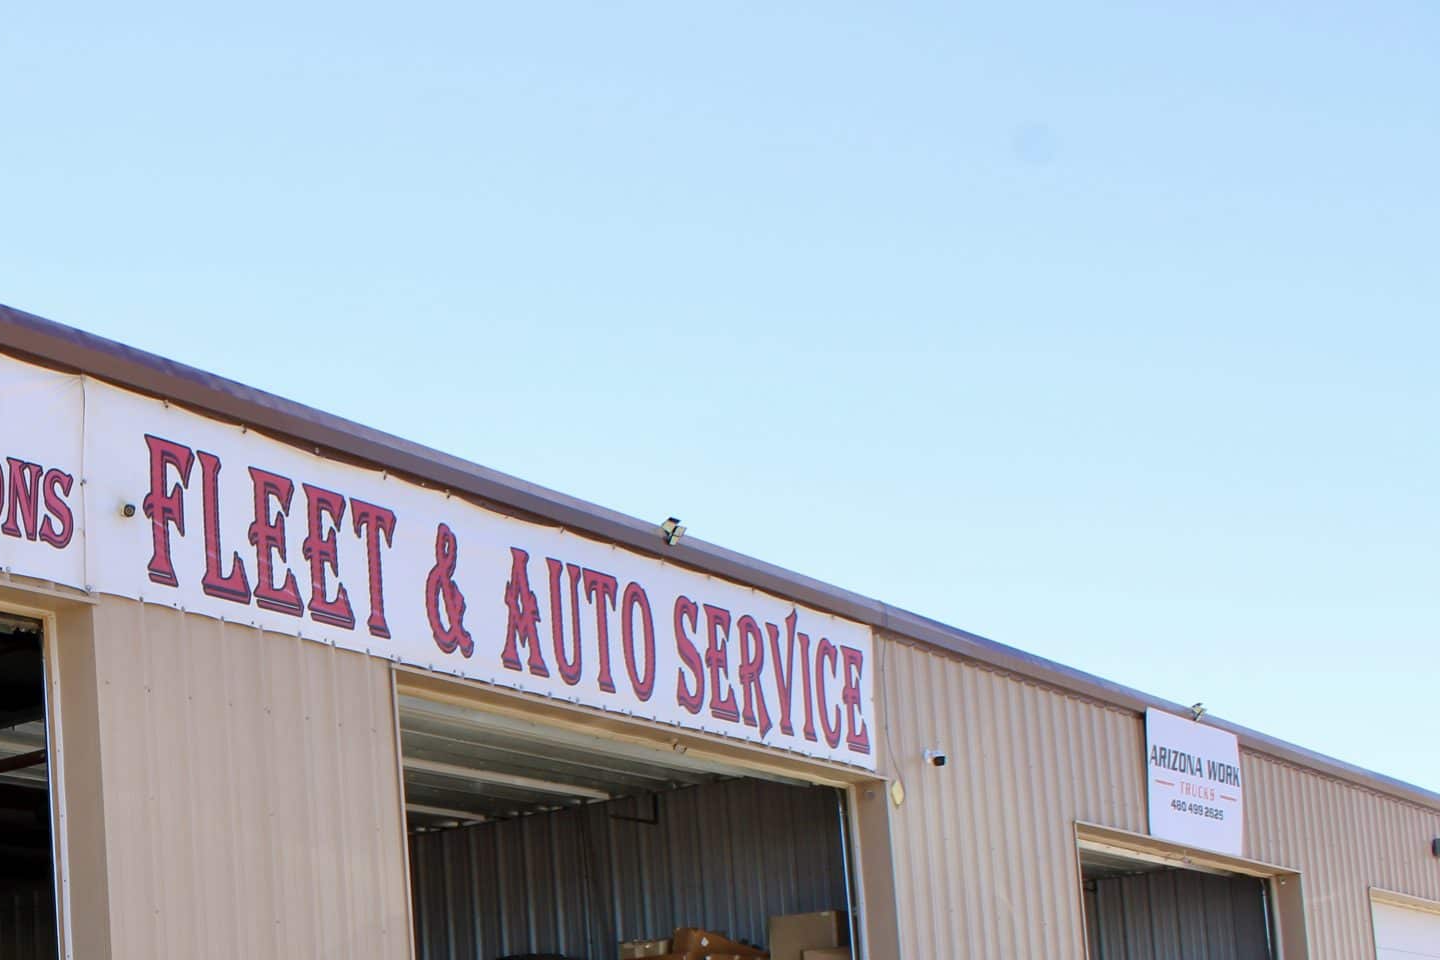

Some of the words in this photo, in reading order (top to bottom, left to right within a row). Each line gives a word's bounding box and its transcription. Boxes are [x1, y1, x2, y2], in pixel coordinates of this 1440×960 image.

[143, 433, 396, 640] FLEET
[424, 521, 474, 658] &
[501, 546, 657, 703] AUTO
[672, 594, 872, 755] SERVICE
[1150, 744, 1203, 778] ARIZONA
[1207, 759, 1240, 788] WORK
[1170, 800, 1187, 812] 480
